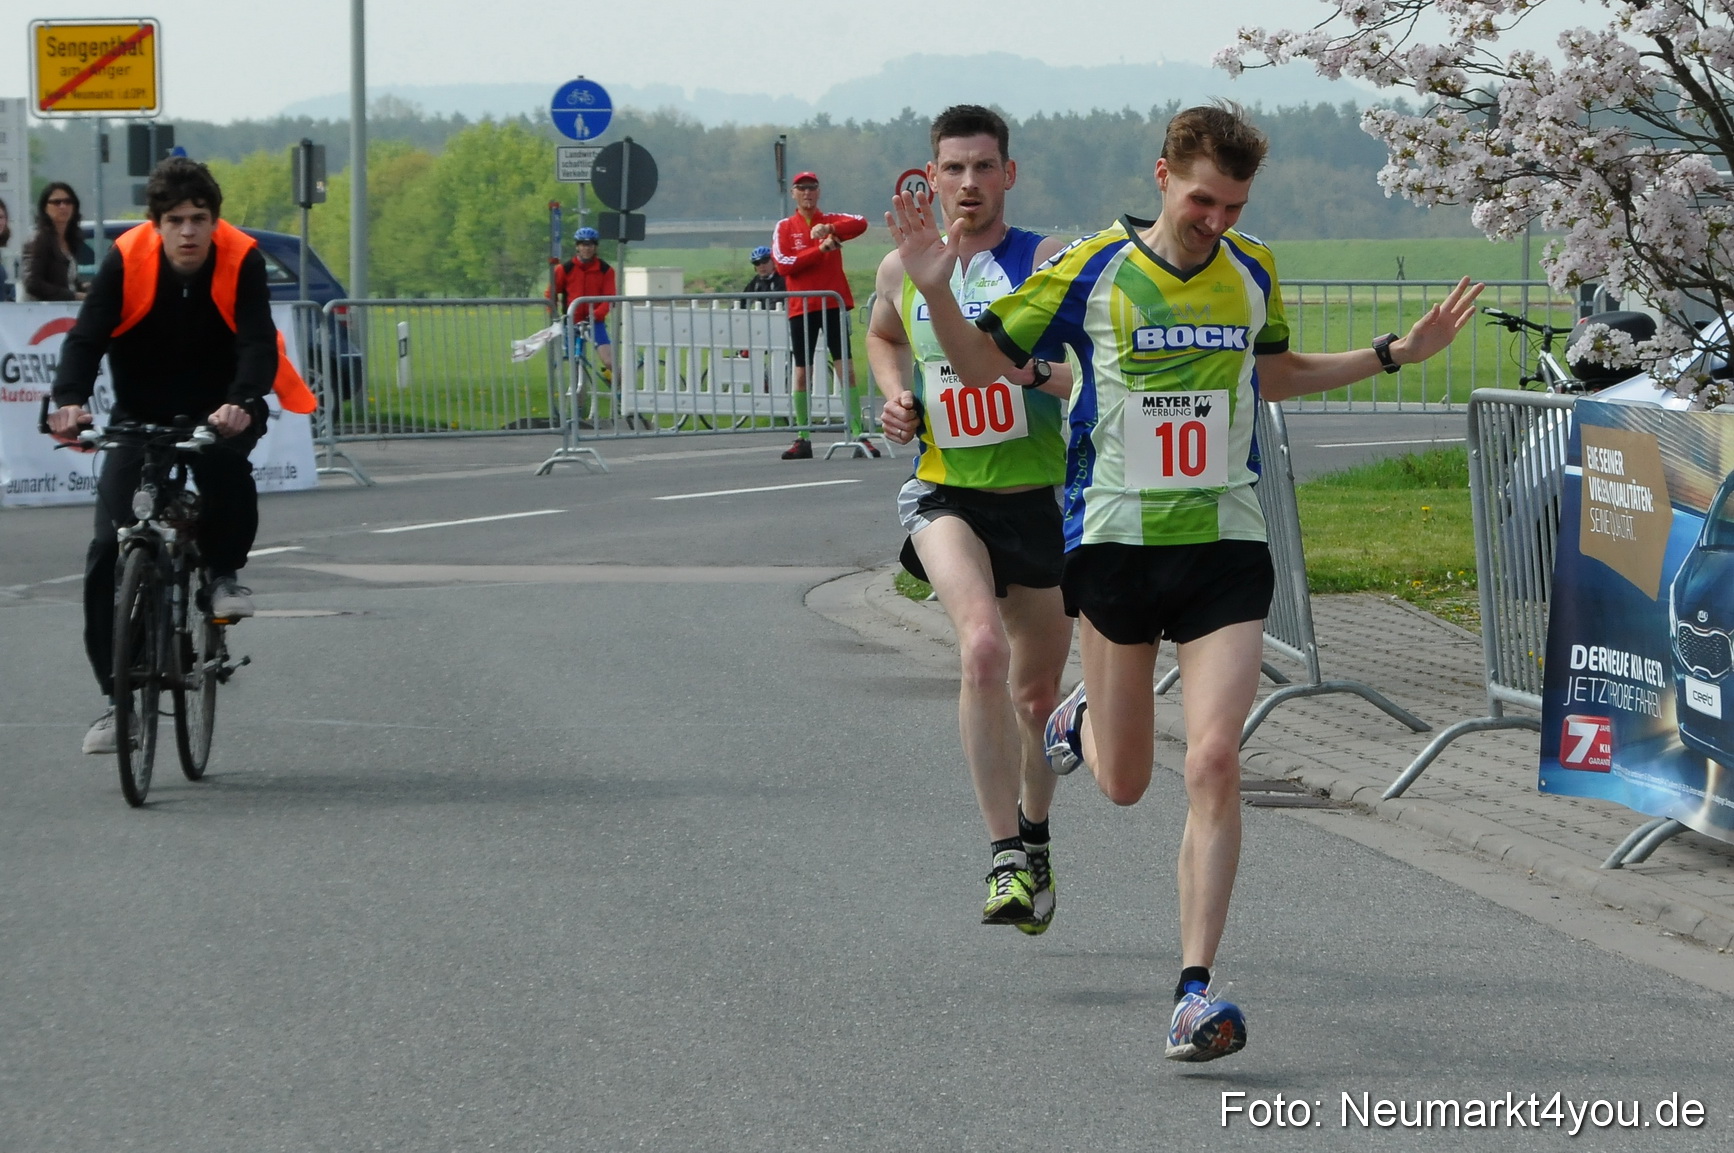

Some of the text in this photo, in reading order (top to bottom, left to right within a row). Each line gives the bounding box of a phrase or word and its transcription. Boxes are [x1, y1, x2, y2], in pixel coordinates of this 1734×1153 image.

[46, 36, 145, 62] Sengenthal
[1132, 323, 1249, 352] BOCK
[939, 382, 1016, 438] 100
[1142, 395, 1192, 408] MEYER
[1142, 407, 1192, 417] WERBUNG
[1155, 420, 1207, 477] 10
[1570, 644, 1608, 672] DER
[1606, 648, 1630, 679] NEUE
[1630, 654, 1644, 682] KIA
[1566, 721, 1600, 764] 7
